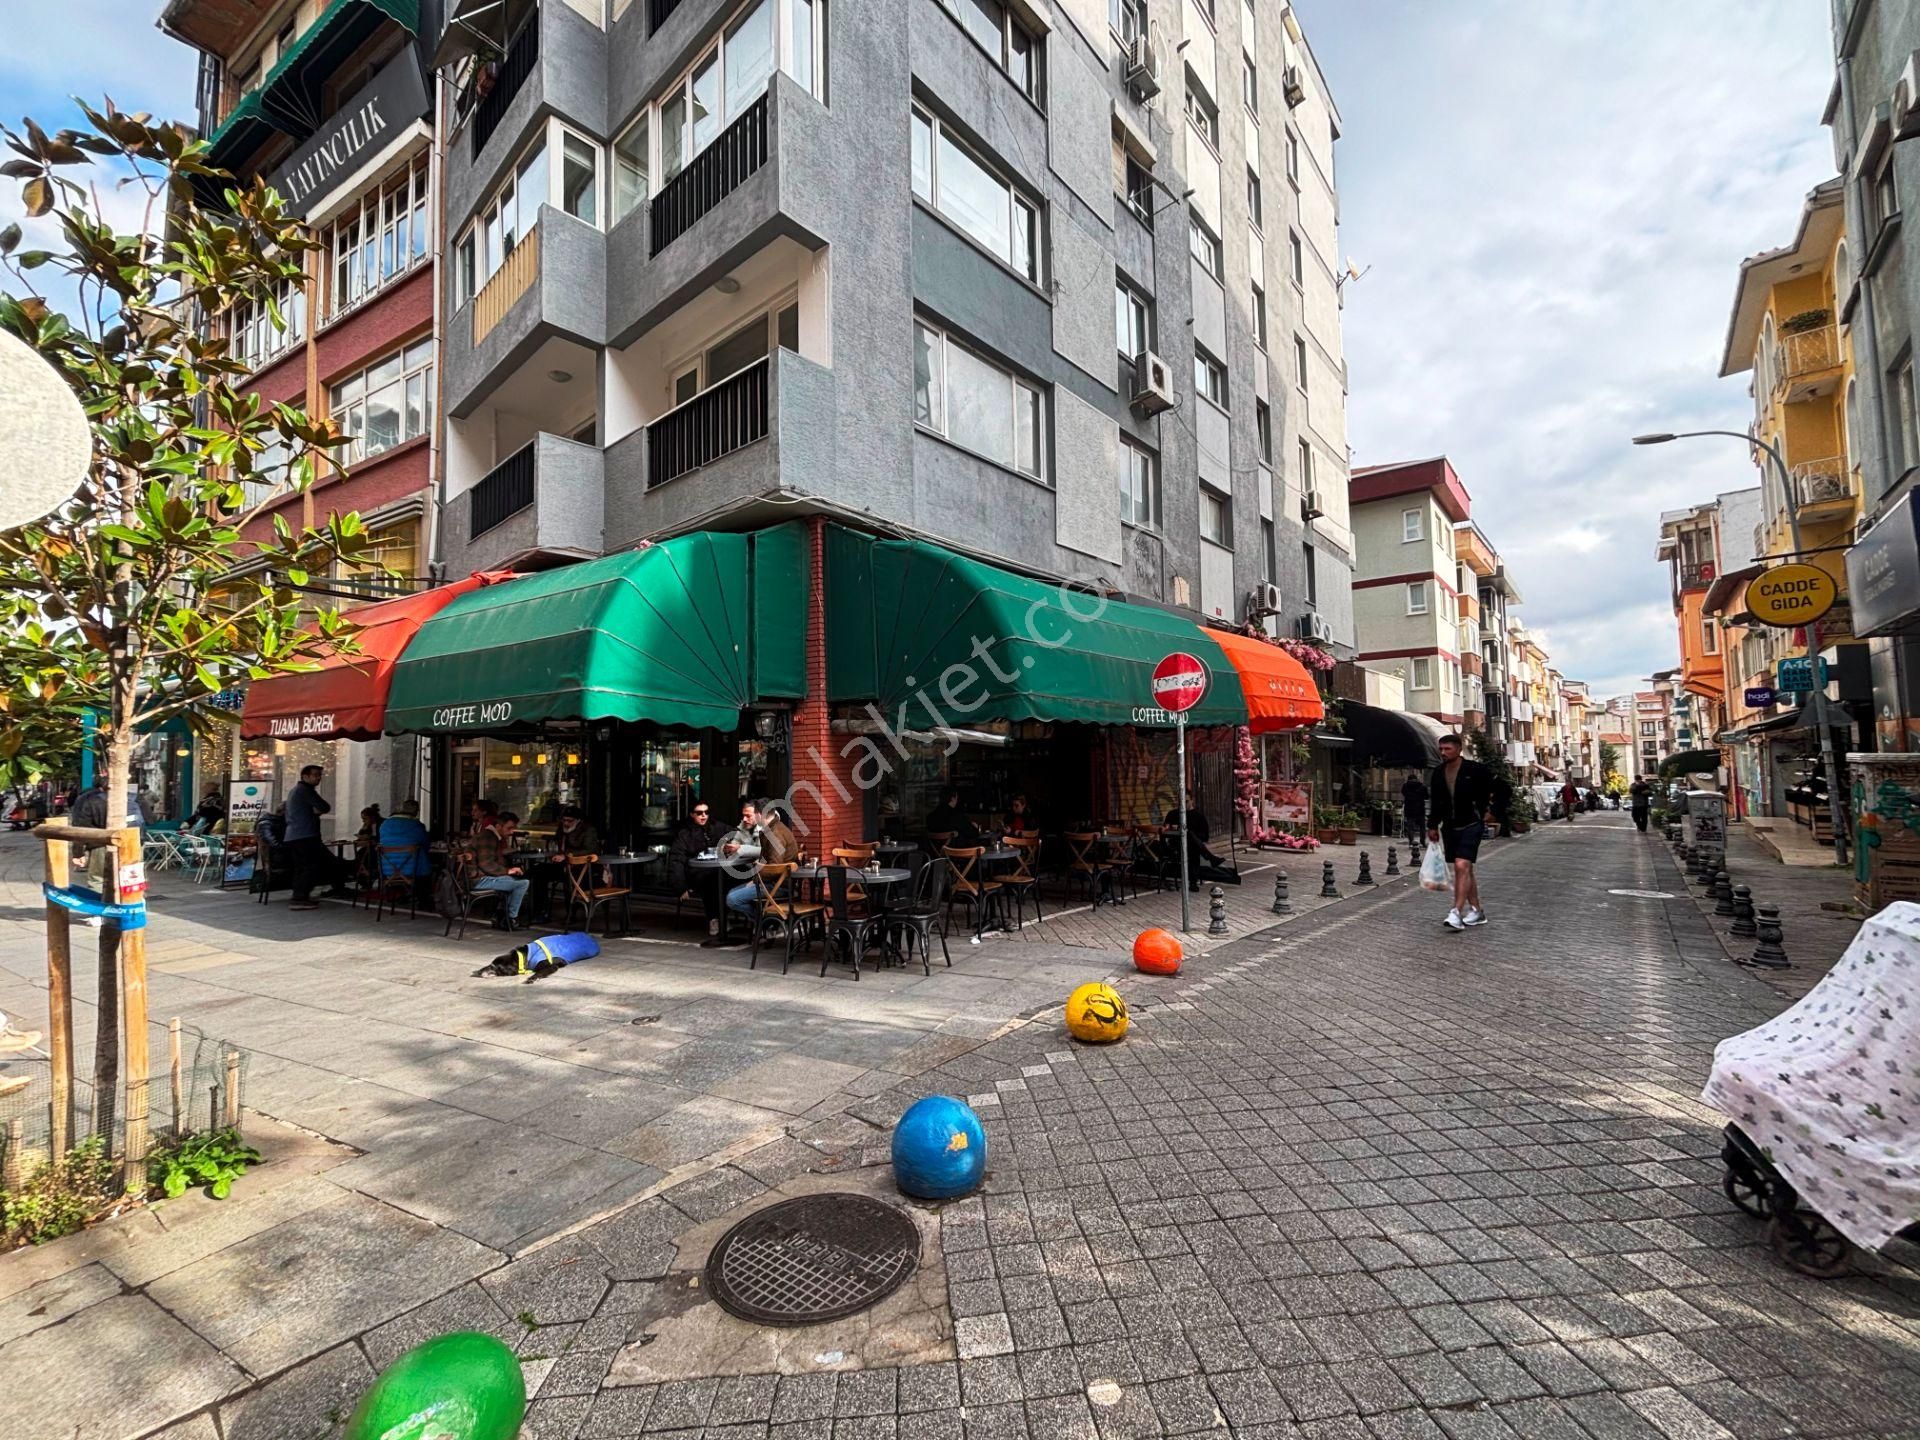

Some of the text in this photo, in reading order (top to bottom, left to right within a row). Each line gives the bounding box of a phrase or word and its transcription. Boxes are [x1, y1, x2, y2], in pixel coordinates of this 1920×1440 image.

[285, 96, 387, 204] YAYINCILIK
[1760, 578, 1820, 596] CADDE
[1771, 595, 1814, 611] GIDA
[1747, 692, 1770, 702] hadi
[433, 701, 512, 727] COFFEE MOD
[1132, 707, 1166, 724] COFFEE
[270, 713, 335, 735] TUANA BÖREK
